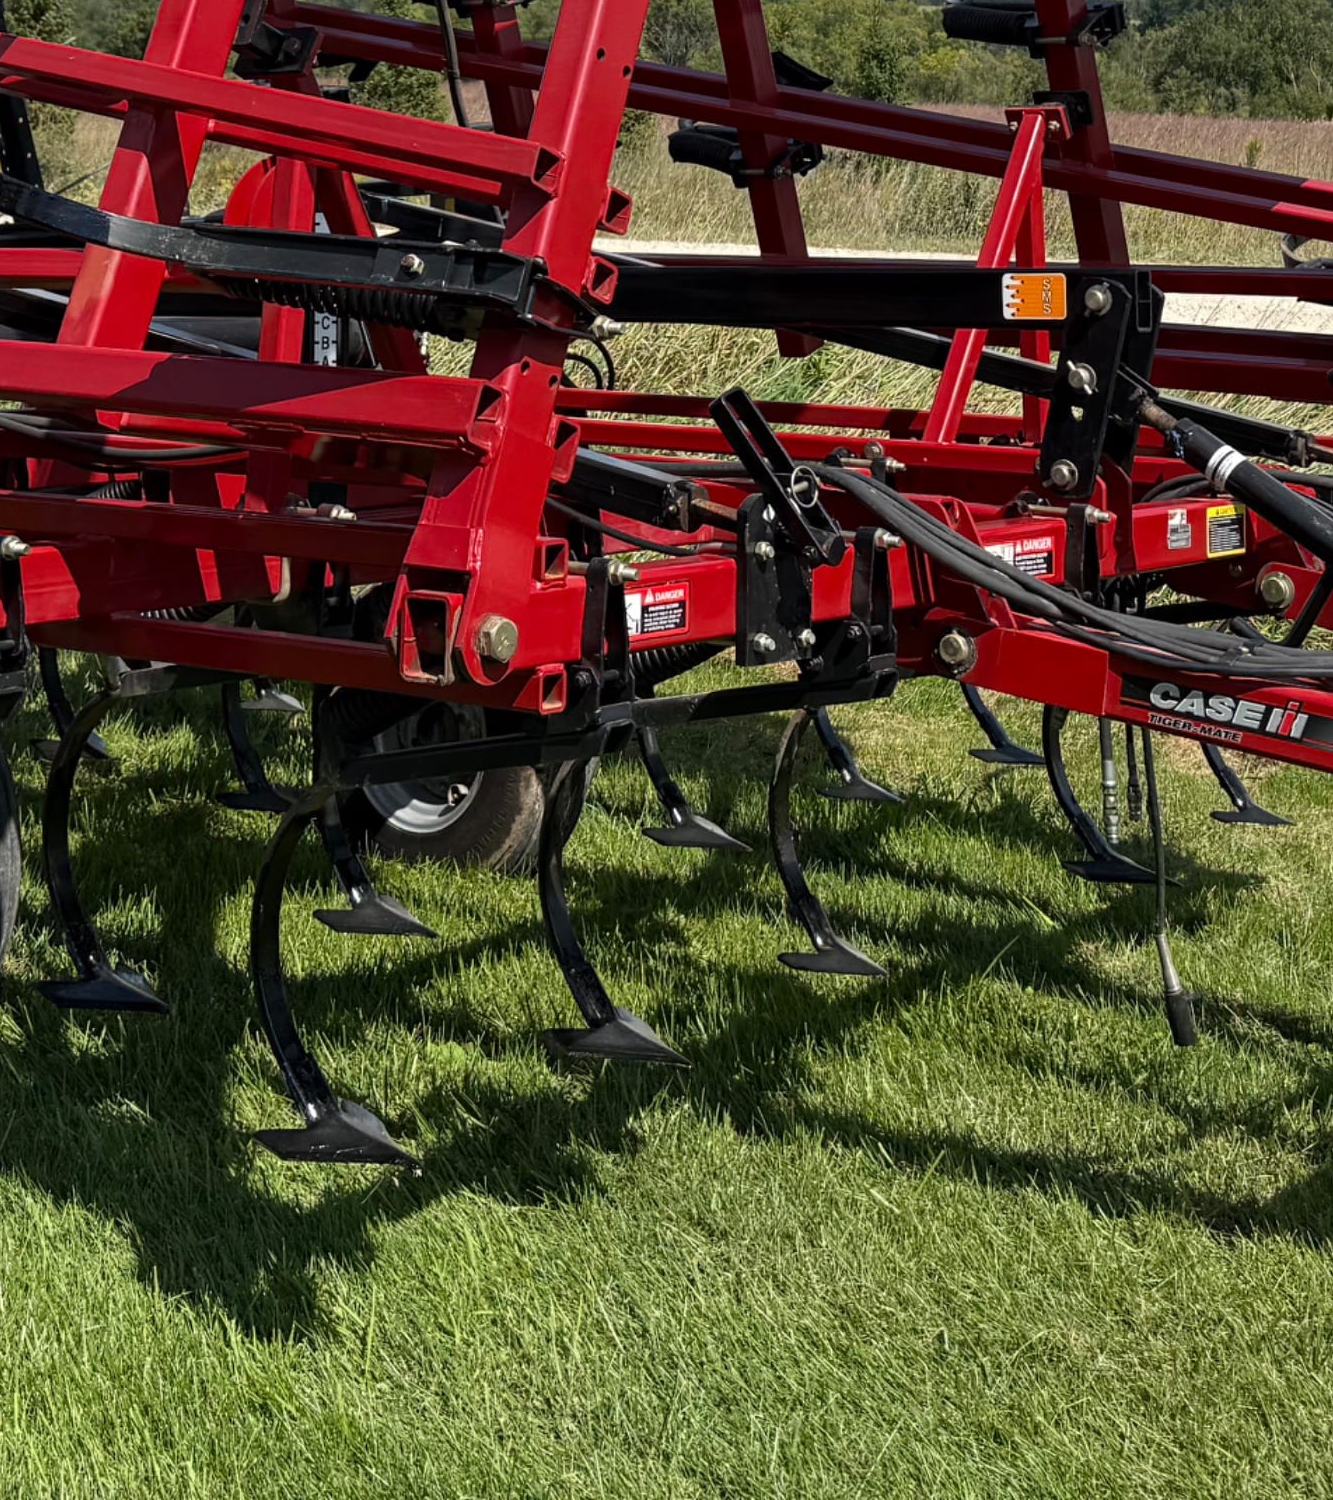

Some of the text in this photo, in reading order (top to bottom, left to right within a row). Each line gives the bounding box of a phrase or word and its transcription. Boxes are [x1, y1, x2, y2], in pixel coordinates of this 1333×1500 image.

[322, 316, 330, 330] C
[322, 336, 330, 350] B
[1023, 537, 1052, 551] DANGER
[655, 589, 684, 602] DANGER
[1150, 682, 1266, 729] CASE
[1148, 712, 1243, 743] TIGER-MATE
